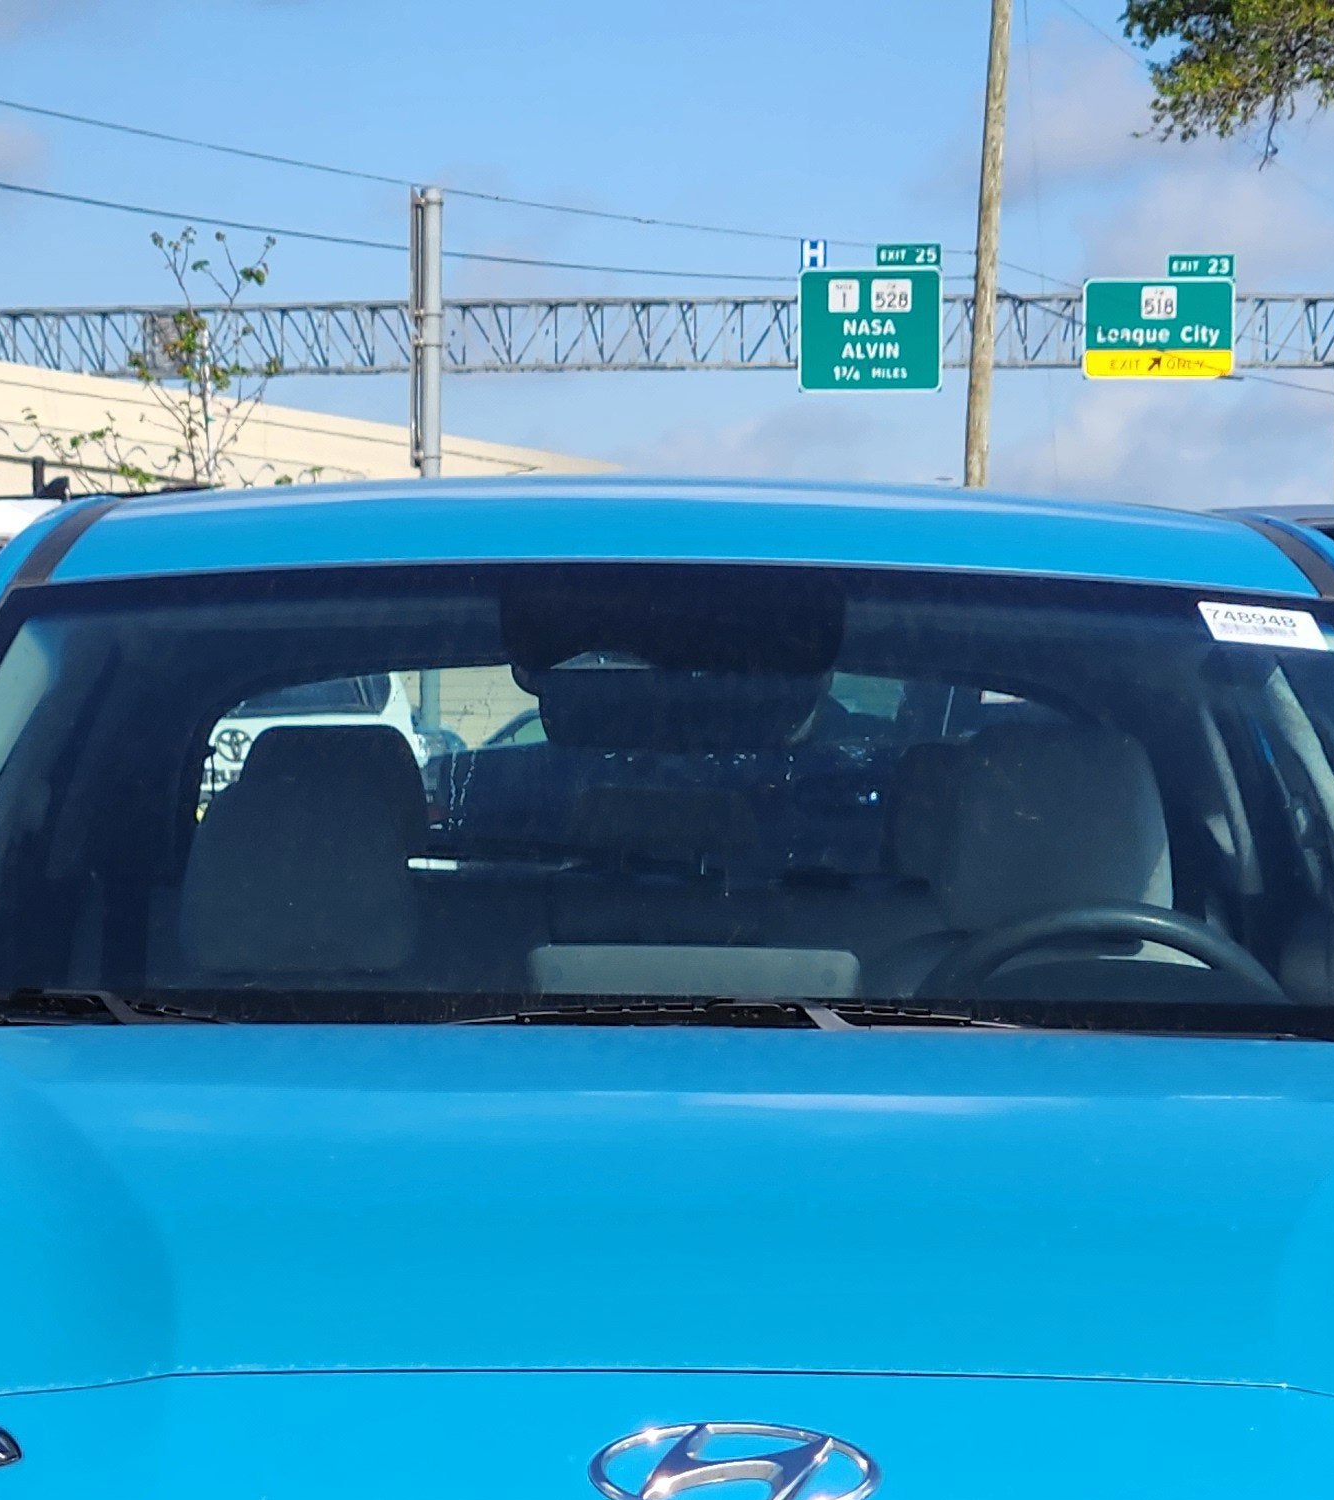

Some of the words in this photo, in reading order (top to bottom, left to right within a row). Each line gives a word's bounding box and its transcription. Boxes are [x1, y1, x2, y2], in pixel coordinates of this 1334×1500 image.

[803, 240, 824, 267] H
[880, 248, 907, 262] EXIT
[915, 247, 937, 264] 25
[1172, 260, 1199, 273] EXIT
[1208, 257, 1230, 275] 23
[875, 291, 909, 308] 528
[1144, 298, 1174, 315] 518
[843, 318, 896, 336] NASA
[1180, 324, 1220, 347] City
[841, 341, 900, 360] ALVIN
[871, 366, 907, 379] MILES
[1110, 359, 1140, 370] EXIT
